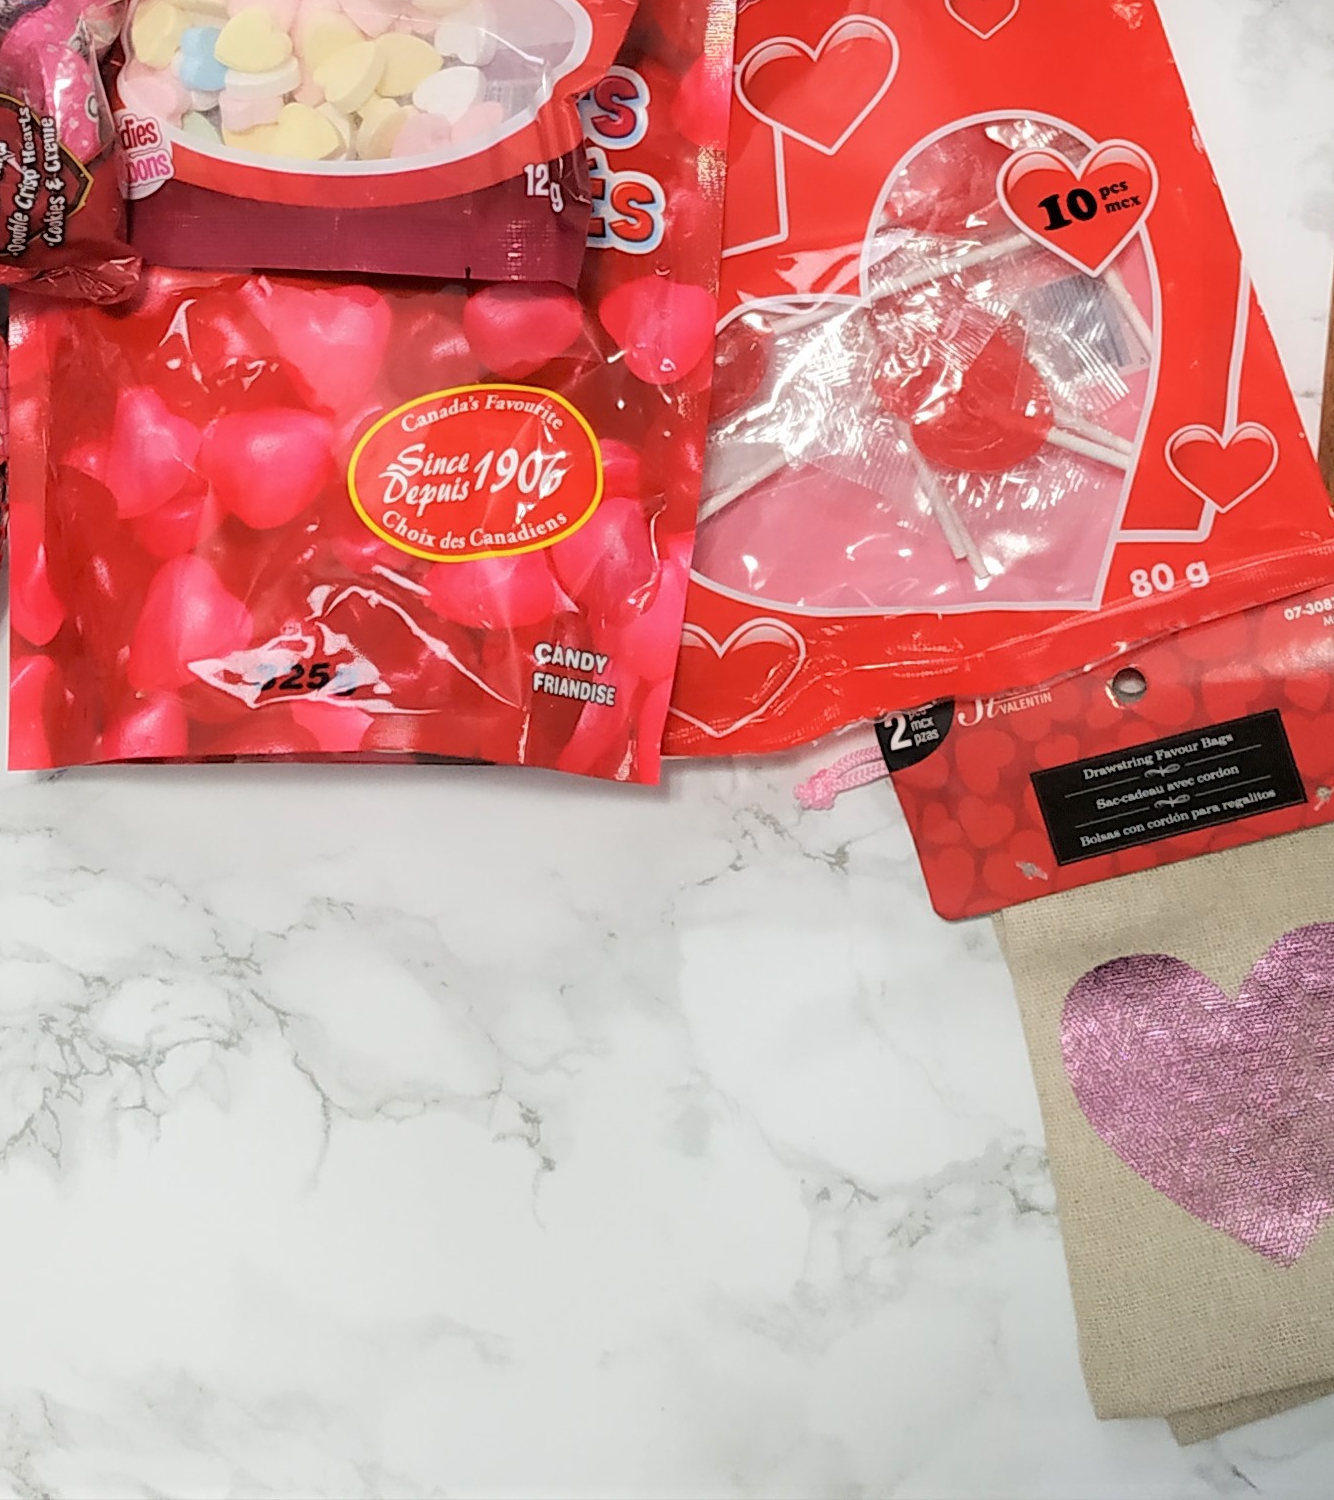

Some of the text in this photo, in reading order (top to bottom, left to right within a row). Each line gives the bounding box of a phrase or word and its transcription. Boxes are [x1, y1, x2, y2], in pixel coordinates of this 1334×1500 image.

[6, 106, 41, 254] Double Crisp Hearts
[45, 176, 65, 191] &
[550, 182, 564, 213] g
[1098, 181, 1129, 200] pcs
[42, 194, 66, 244] Cookies
[1037, 188, 1098, 231] 10
[1104, 195, 1142, 213] mcx
[400, 393, 564, 433] Canada's Favourite
[385, 443, 568, 500] Since 1906
[378, 471, 470, 518] Depuis
[381, 509, 568, 549] Choix des Canadiens
[1128, 559, 1210, 598] 80 g
[534, 642, 608, 675] CANDY
[533, 672, 616, 706] FRIANDISE
[1000, 691, 1053, 716] VALENTIN
[883, 712, 913, 751] 2
[910, 716, 935, 732] mcx
[913, 728, 941, 747] pzas
[1082, 732, 1235, 781] Drawstring Favour Bags
[1096, 764, 1240, 811] Sac-cadeau avec cordon
[1079, 788, 1277, 848] Bolsas con cordón para regalitos
